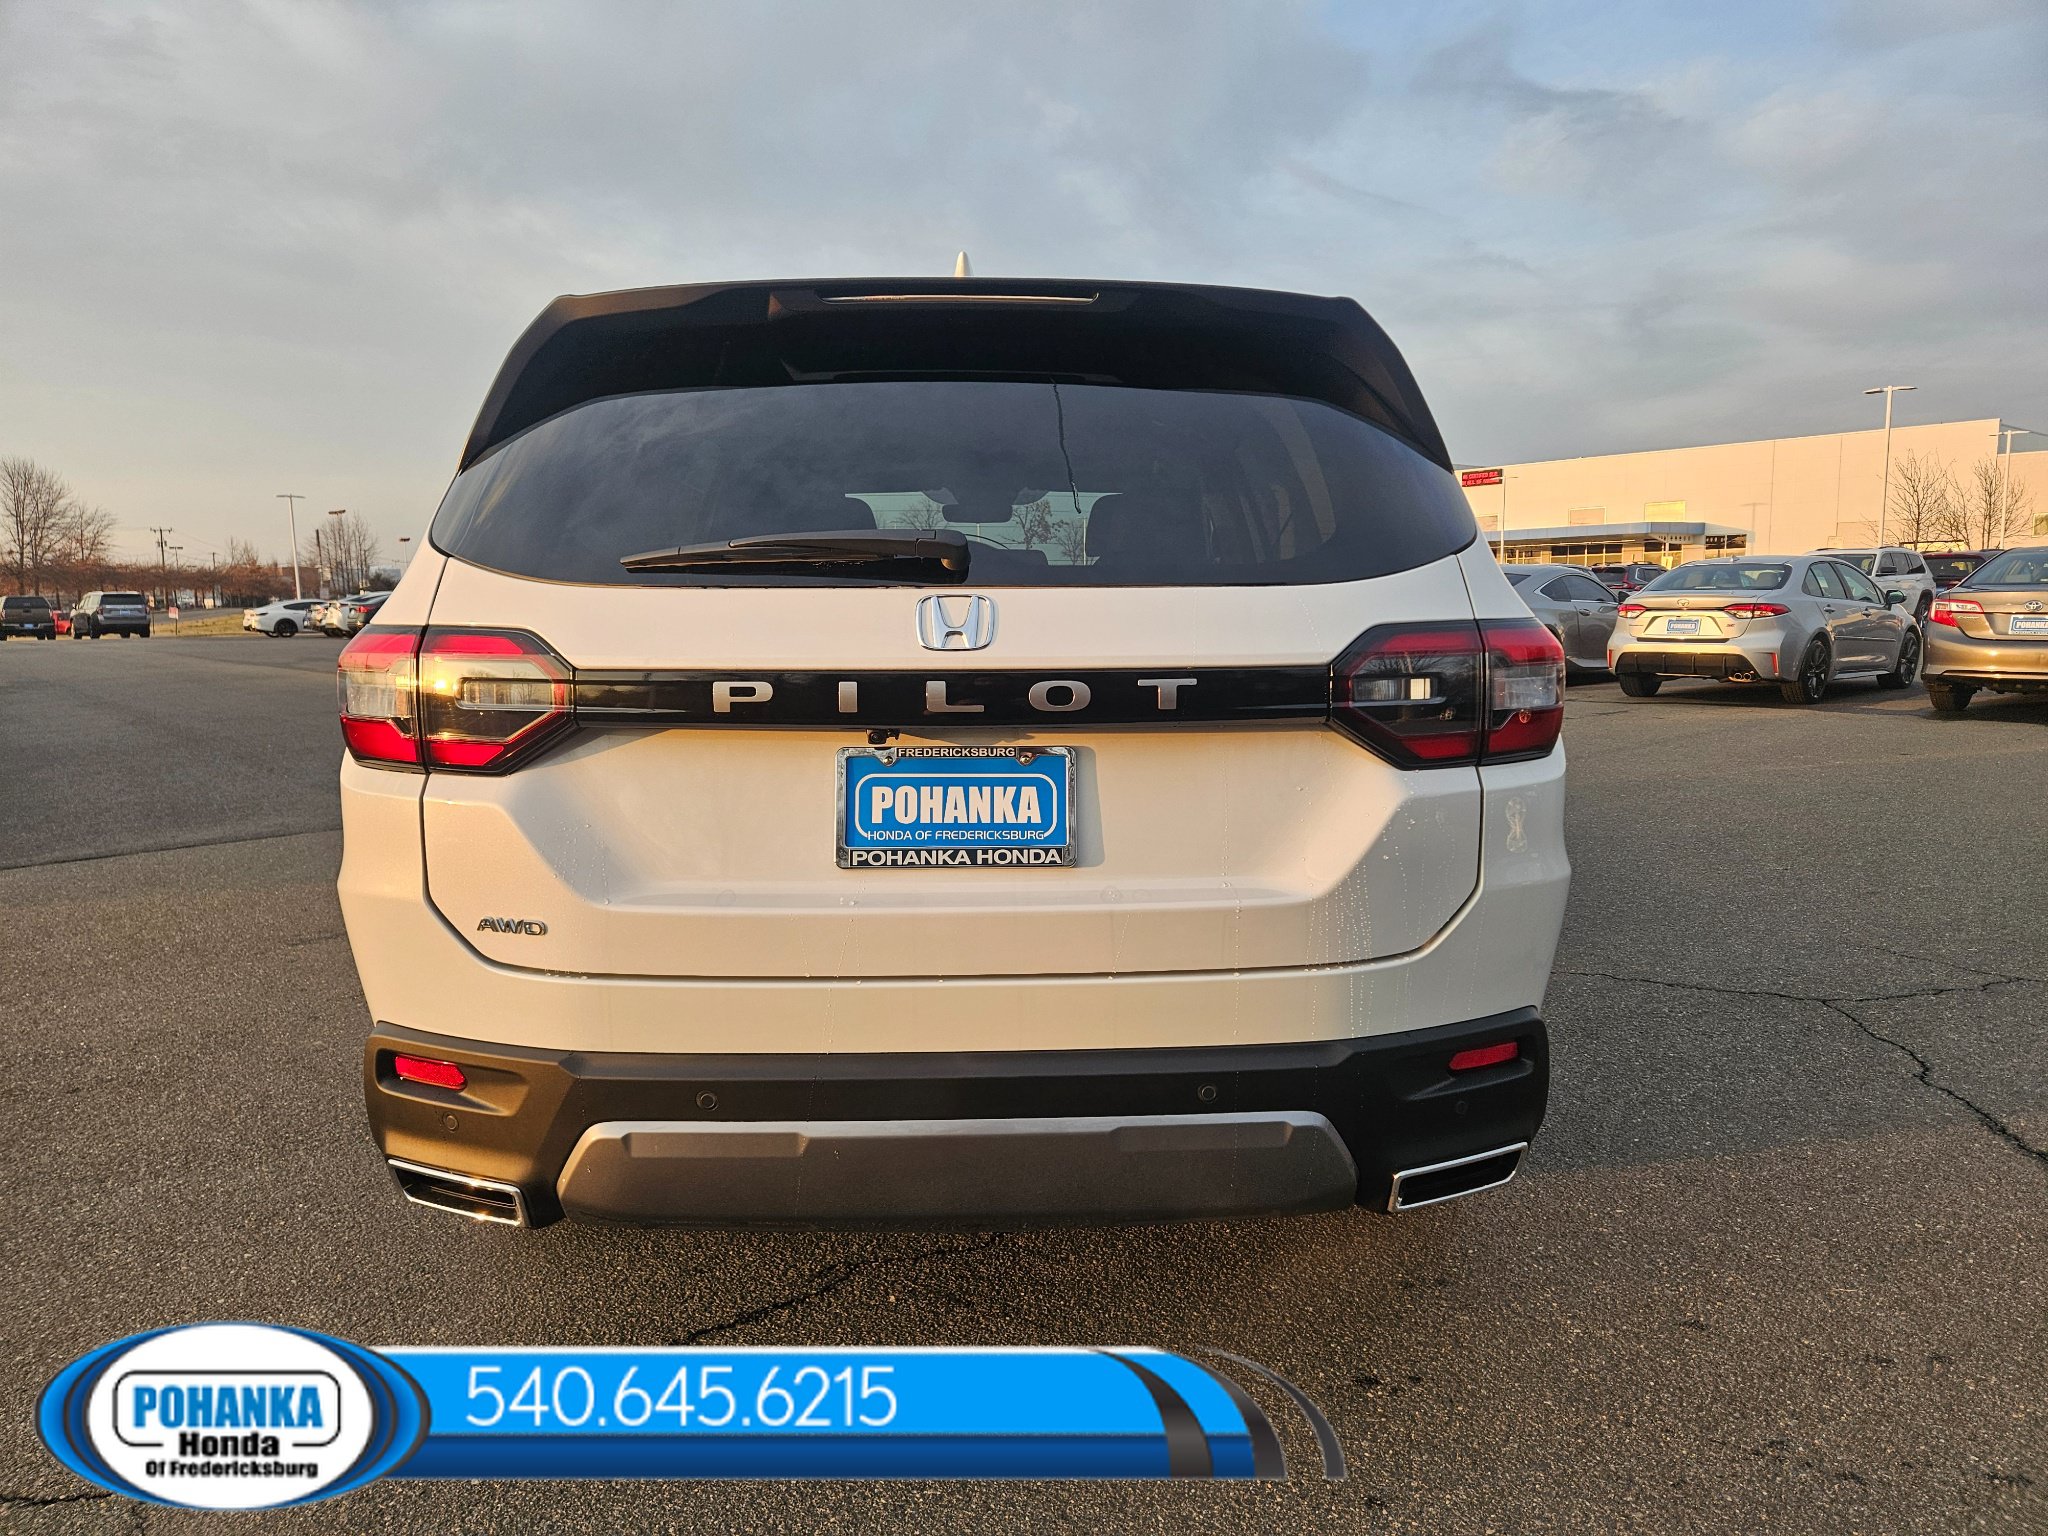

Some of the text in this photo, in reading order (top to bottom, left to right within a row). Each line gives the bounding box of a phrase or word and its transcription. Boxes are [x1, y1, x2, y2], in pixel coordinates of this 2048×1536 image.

[712, 677, 1198, 714] PILOT
[897, 747, 1016, 758] FREDERICKSBURG
[871, 785, 1042, 825] POHANKA
[867, 830, 1045, 841] HONDA OF FREDERICKSBURG
[852, 848, 1063, 866] POHANKA HONDA
[476, 916, 548, 936] AWD
